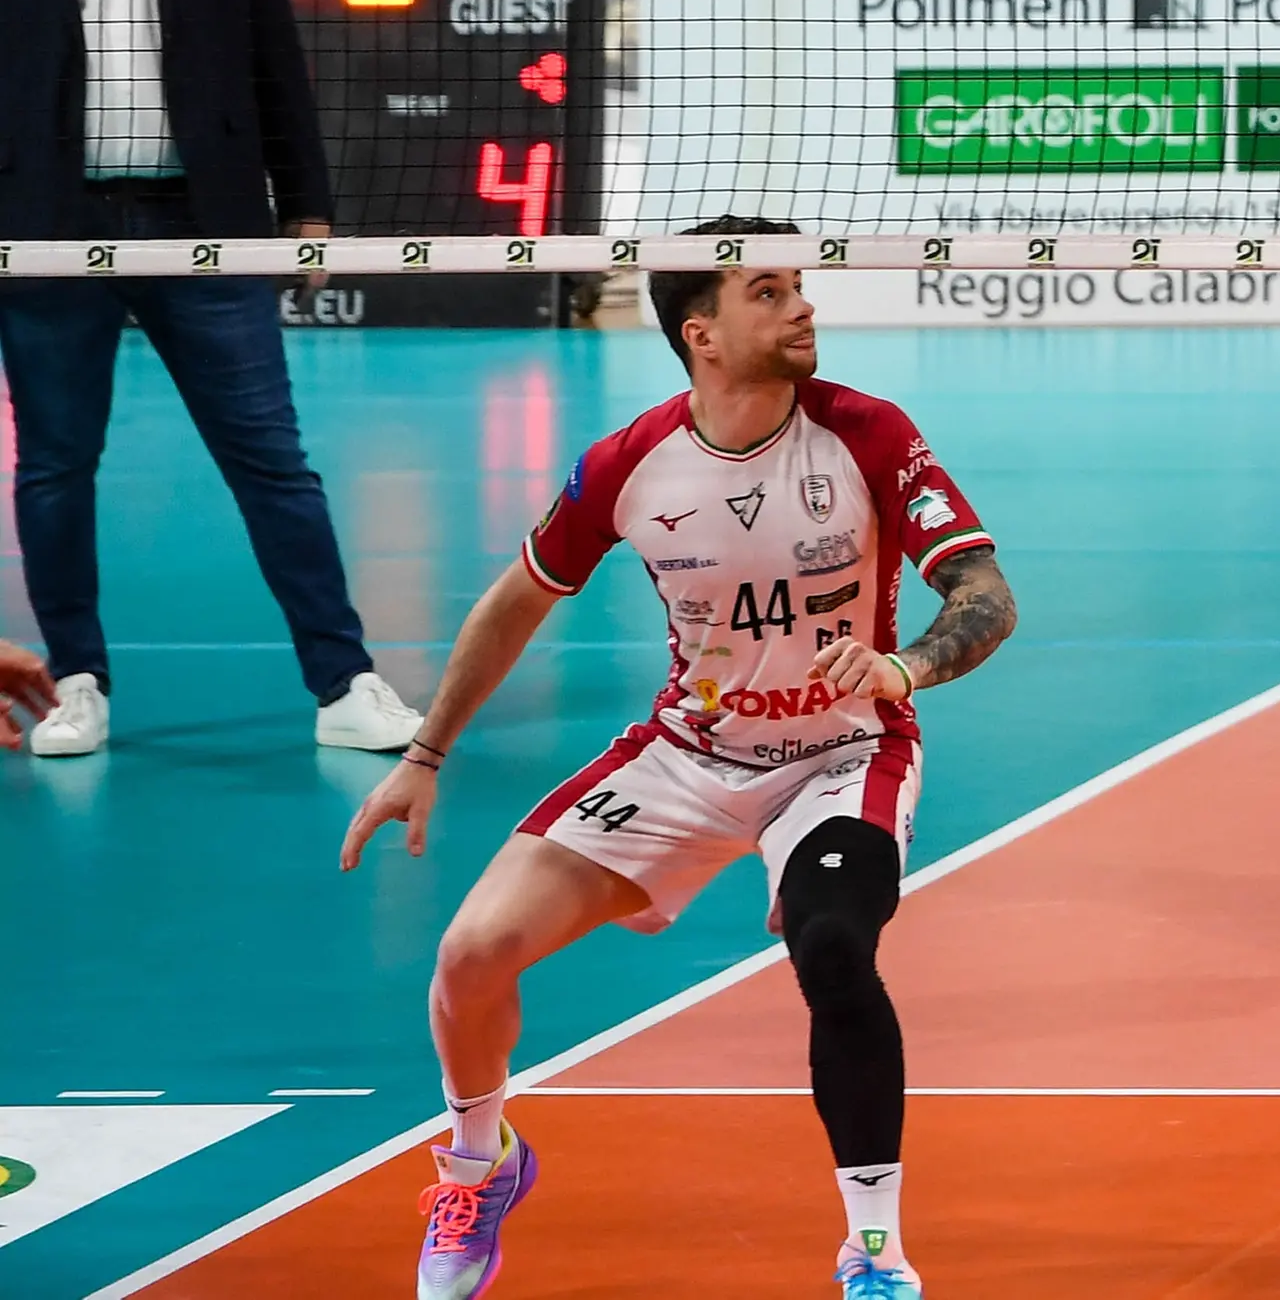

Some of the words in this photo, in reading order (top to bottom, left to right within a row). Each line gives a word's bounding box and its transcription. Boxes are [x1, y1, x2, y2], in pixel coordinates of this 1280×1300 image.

[915, 93, 1207, 148] GAROFOLI
[477, 141, 552, 236] 4
[936, 200, 980, 231] Via
[916, 268, 1095, 317] Reggio
[731, 578, 797, 642] 44
[575, 789, 641, 833] 44
